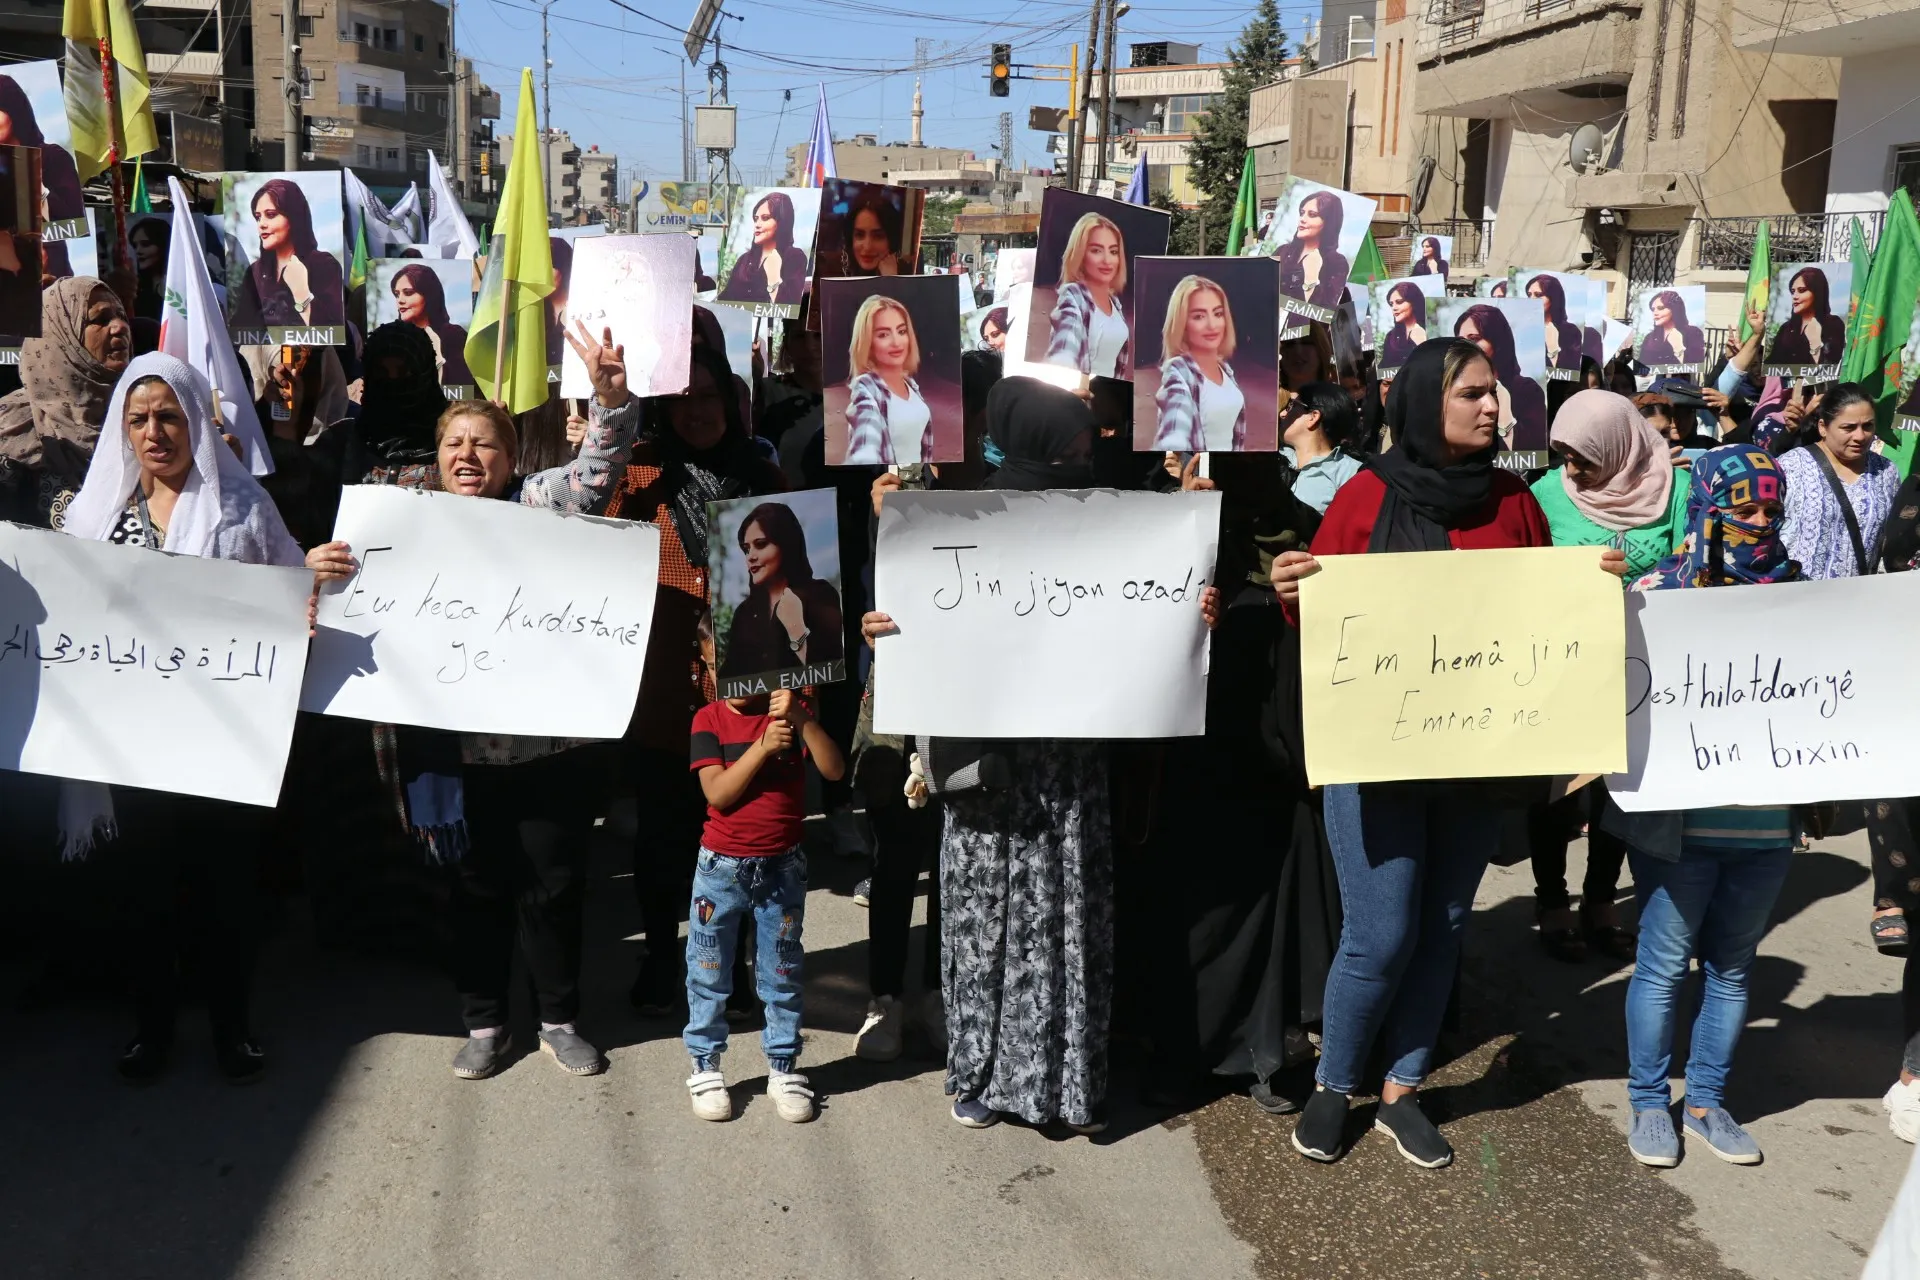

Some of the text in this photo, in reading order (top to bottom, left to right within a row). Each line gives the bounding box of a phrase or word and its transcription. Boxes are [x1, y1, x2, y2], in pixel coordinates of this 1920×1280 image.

[42, 219, 77, 241] MÎNÎ
[1285, 299, 1325, 321] EMÎNÎ
[233, 326, 334, 344] JINA EMÎNÎ
[1280, 327, 1303, 340] MÎNÎ
[0, 353, 21, 364] JIN
[1381, 369, 1398, 380] JIN
[1546, 368, 1572, 381] MÎNÎ
[1764, 366, 1793, 377] JINA
[443, 385, 463, 400] ÎNÎ
[1897, 418, 1920, 432] JIN
[932, 545, 1002, 611] Jin
[1014, 570, 1104, 617] jiyan
[89, 634, 145, 672] الحياة
[1331, 613, 1399, 686] Em
[1513, 634, 1580, 687] jin
[154, 646, 186, 679] هي
[723, 662, 833, 699] JINA EMÎNÎ
[1689, 718, 1869, 771] bin bixin.
